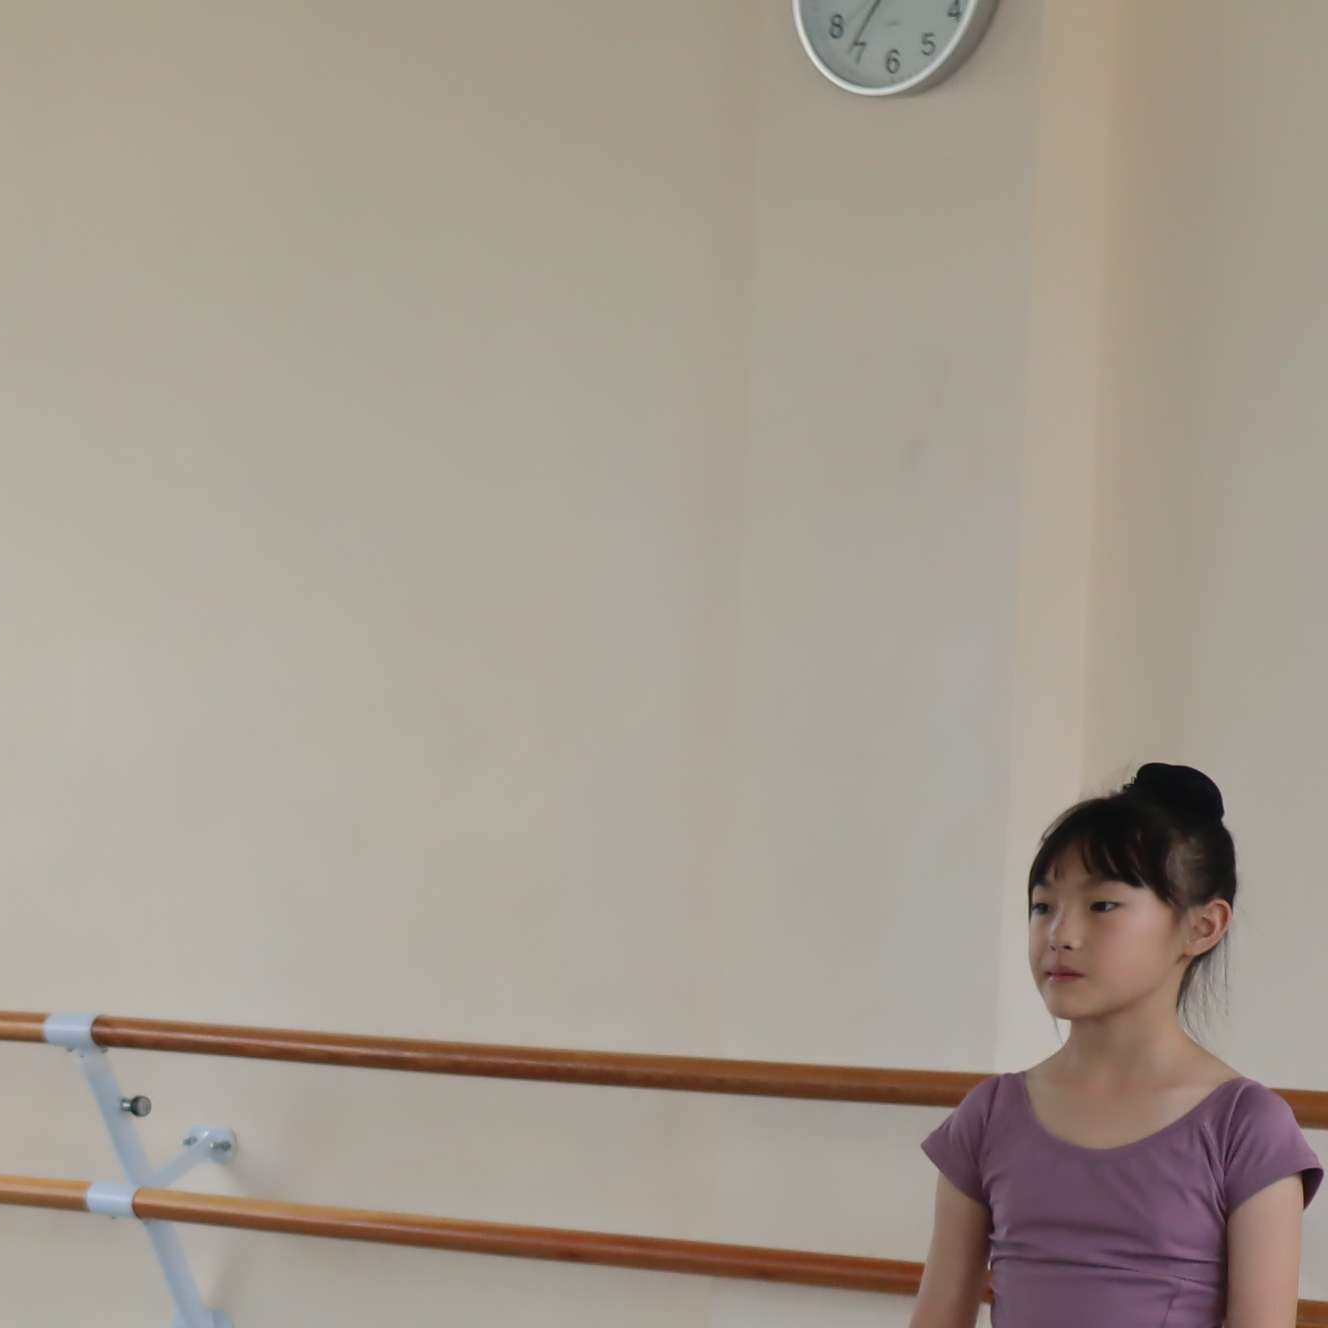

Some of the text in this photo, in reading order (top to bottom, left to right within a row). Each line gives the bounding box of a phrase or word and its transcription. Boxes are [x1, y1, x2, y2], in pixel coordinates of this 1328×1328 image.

[828, 14, 845, 39] 8
[853, 41, 867, 64] 7
[920, 32, 937, 56] 5
[885, 49, 901, 74] 6
